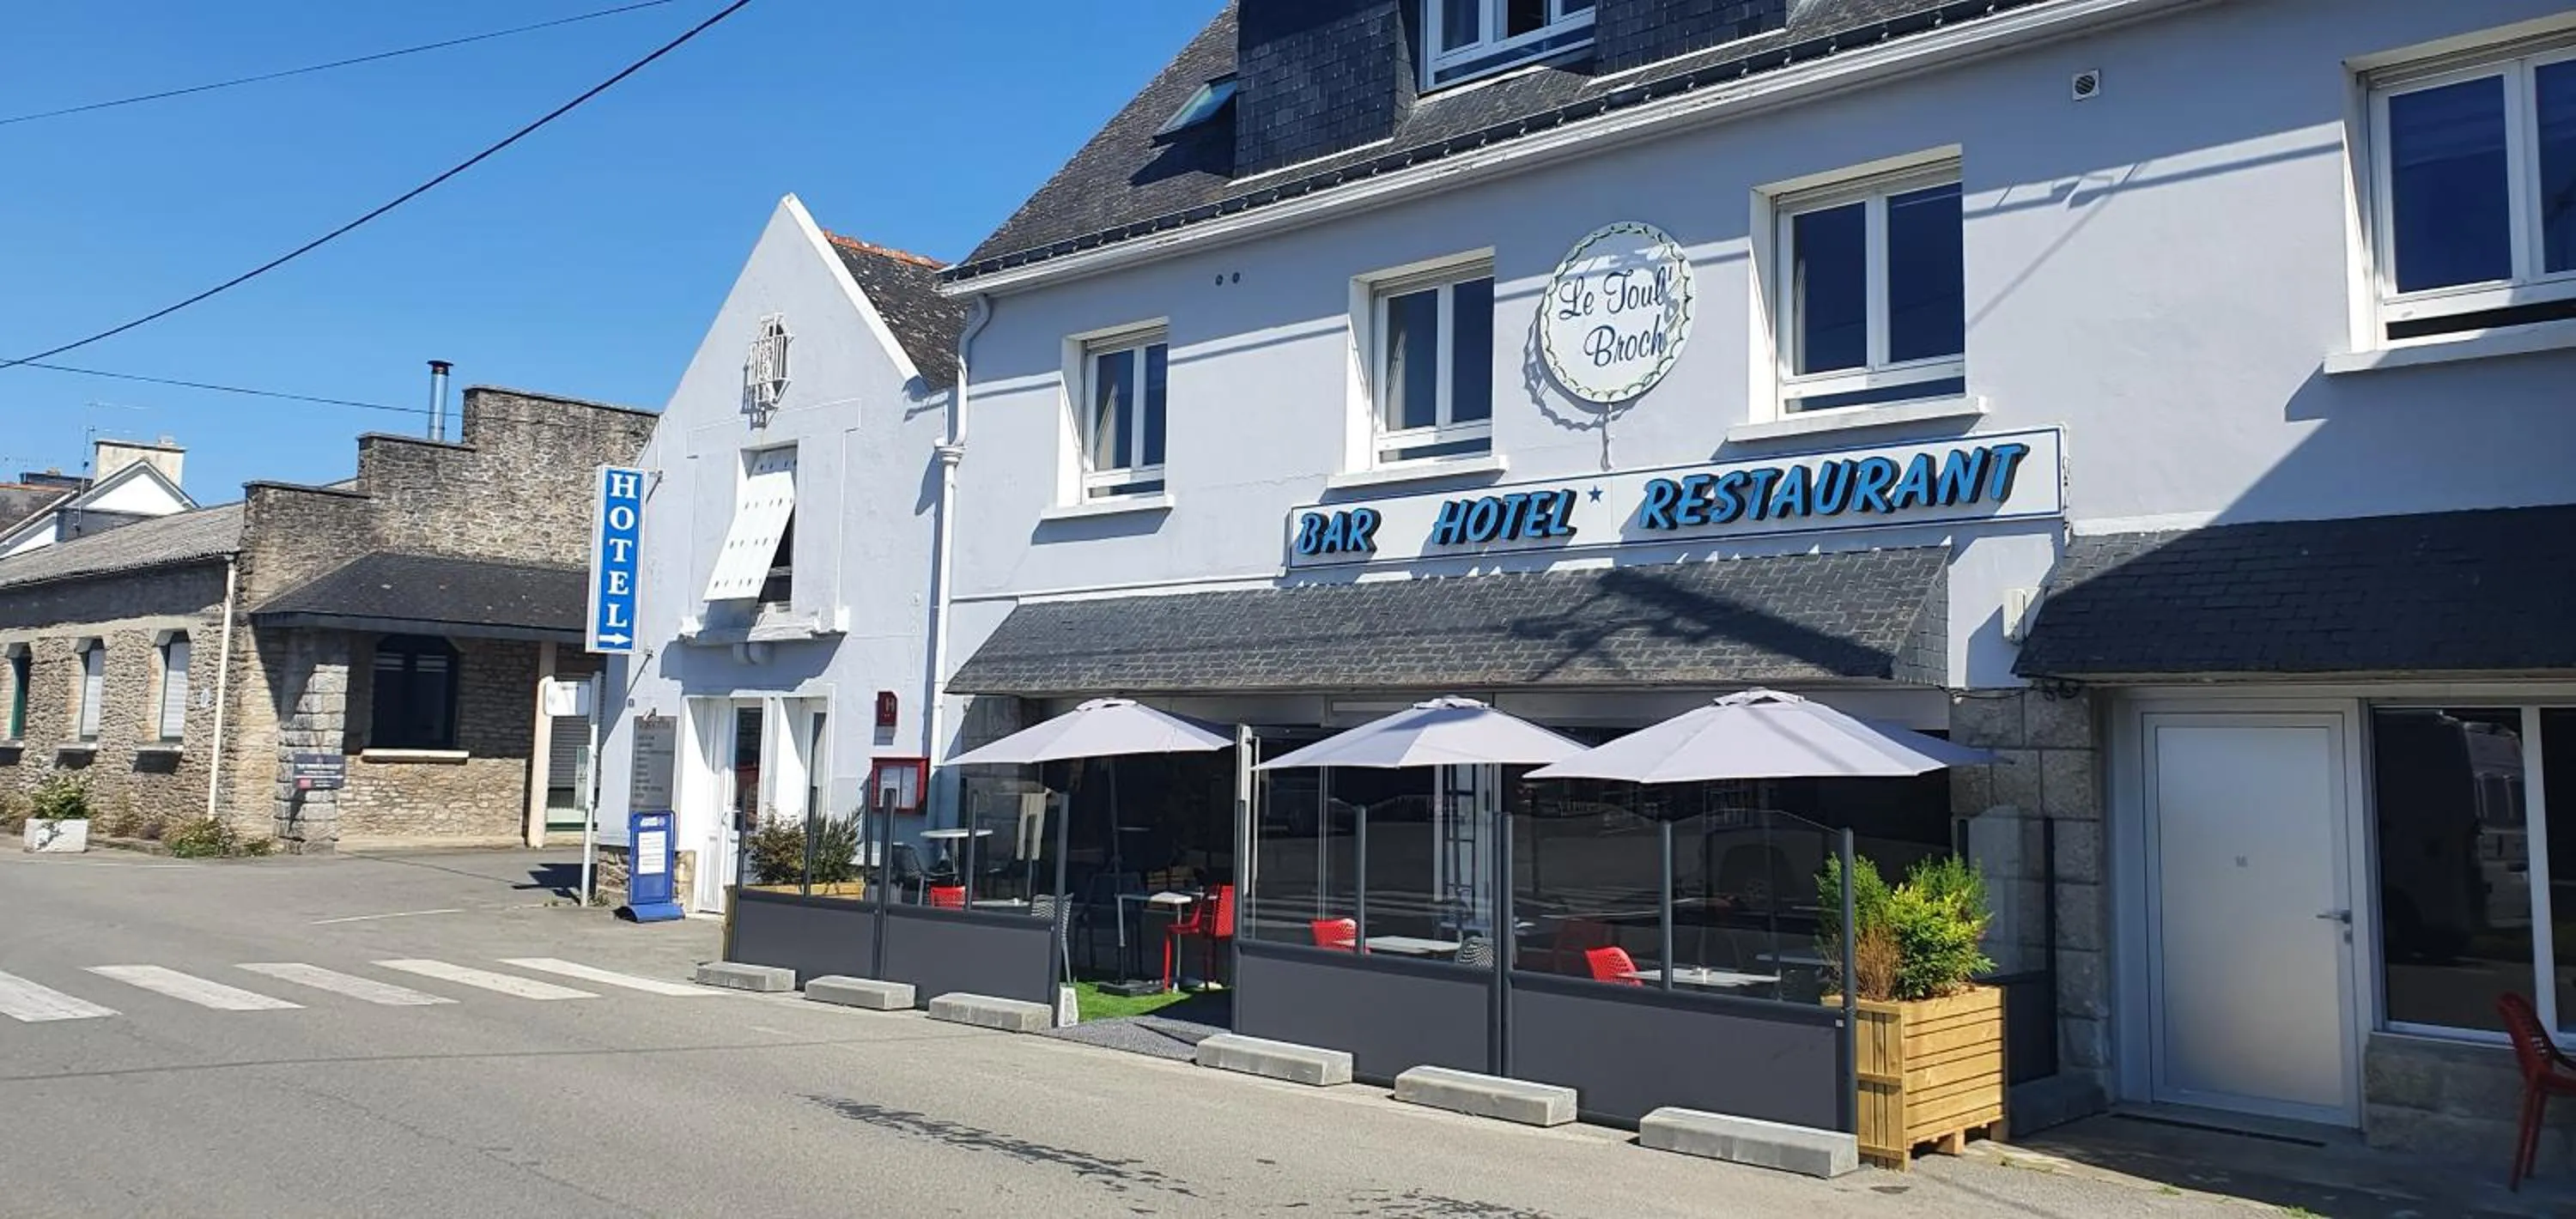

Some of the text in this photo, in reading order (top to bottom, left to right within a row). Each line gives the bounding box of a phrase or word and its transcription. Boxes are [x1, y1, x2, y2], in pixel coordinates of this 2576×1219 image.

[1558, 265, 1673, 321] Le Toul'
[1583, 313, 1666, 368] Broch
[1297, 442, 2030, 555] BAR HOTEL RESTAURANT
[605, 473, 638, 628] HOTEL
